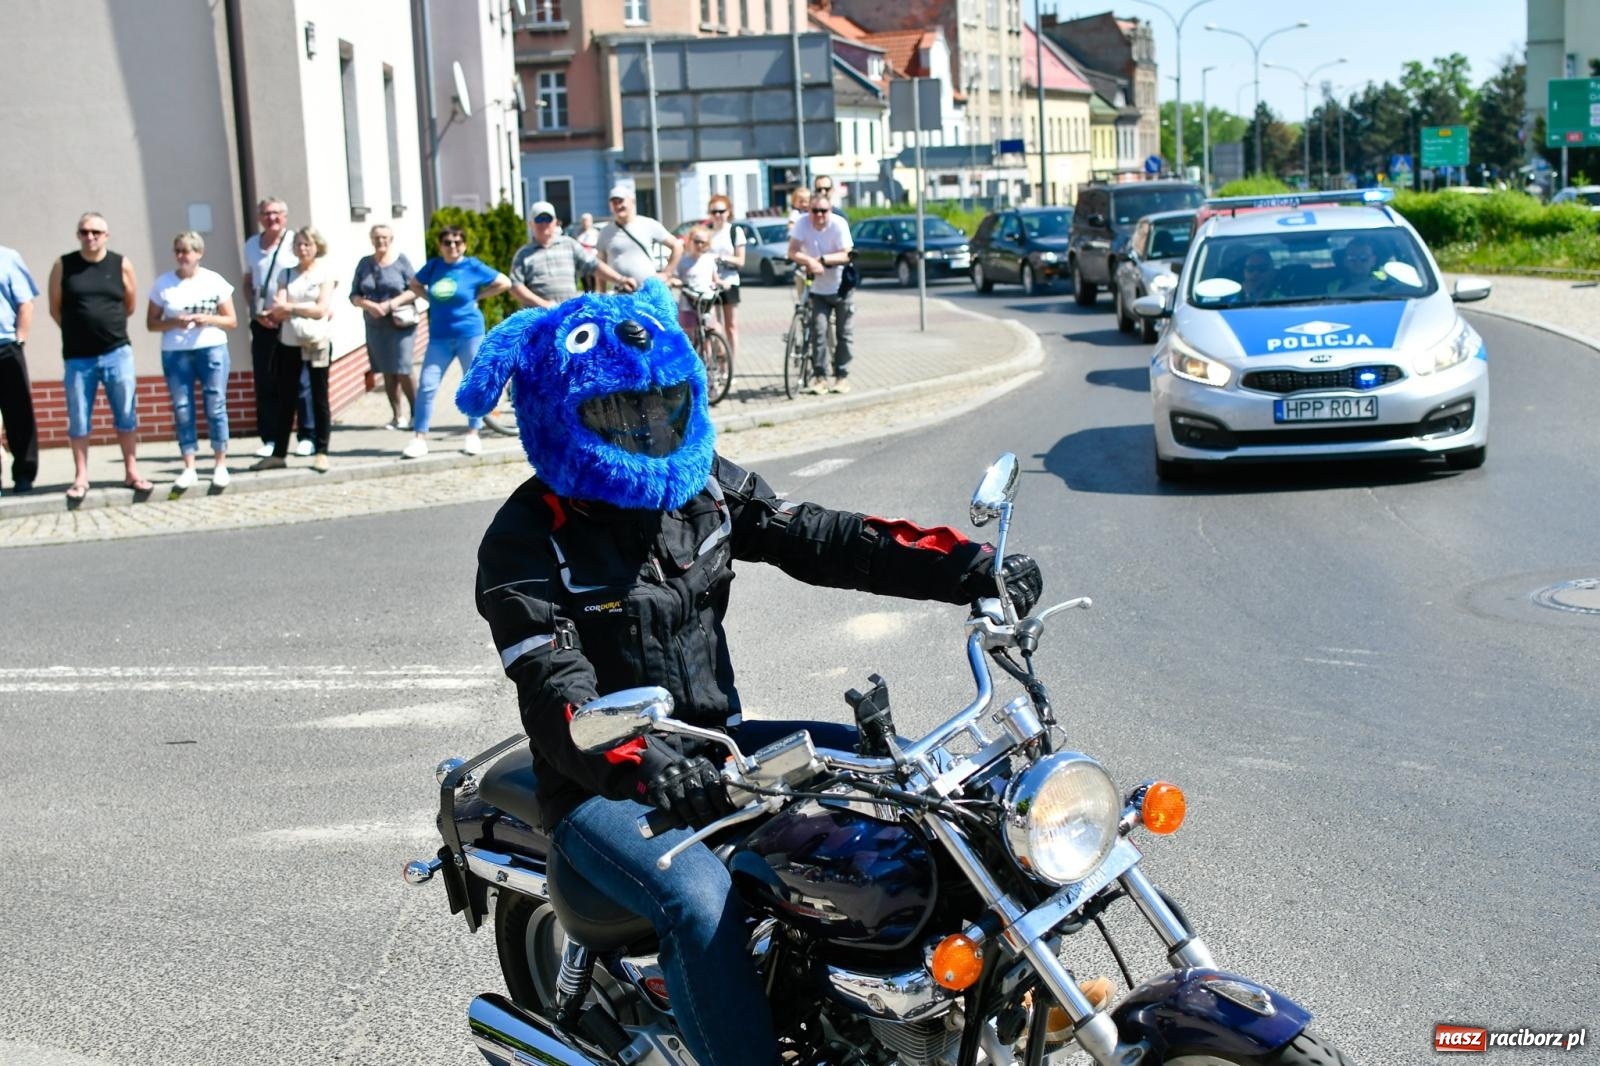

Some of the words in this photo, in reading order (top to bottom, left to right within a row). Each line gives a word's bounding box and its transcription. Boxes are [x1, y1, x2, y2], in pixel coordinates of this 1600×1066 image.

[1266, 333, 1374, 351] POLICJA
[1285, 401, 1324, 418] HPP
[1330, 399, 1374, 417] R014
